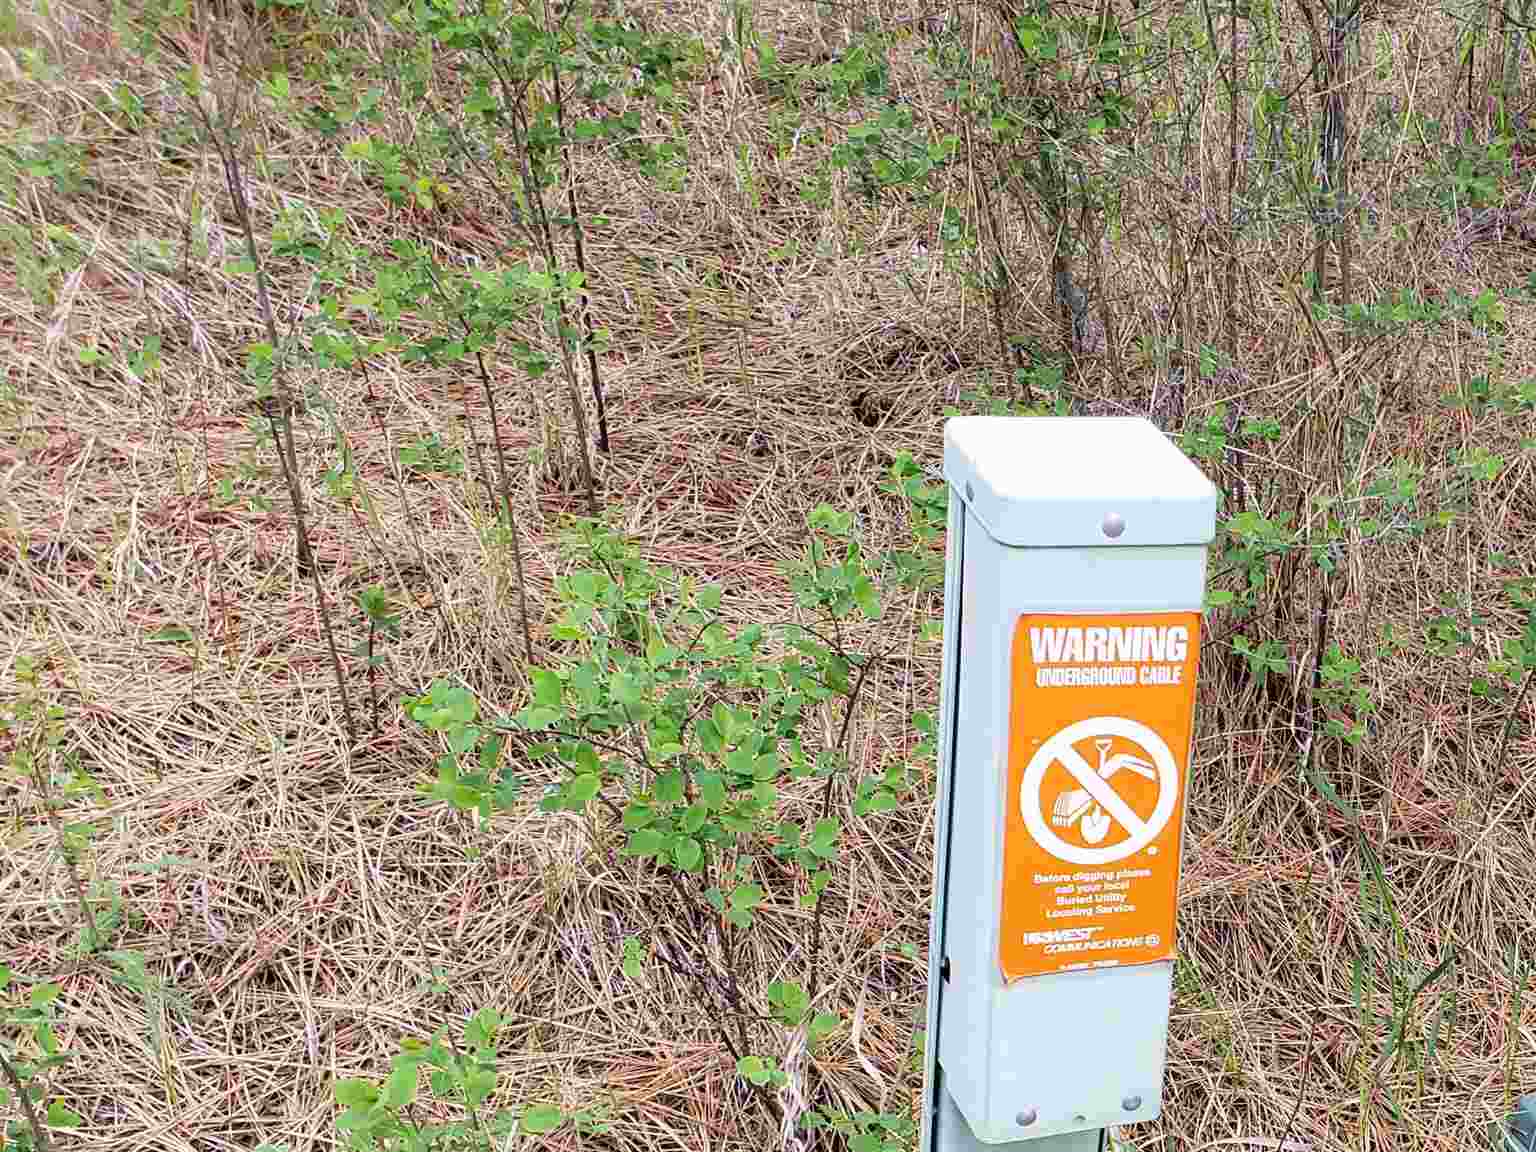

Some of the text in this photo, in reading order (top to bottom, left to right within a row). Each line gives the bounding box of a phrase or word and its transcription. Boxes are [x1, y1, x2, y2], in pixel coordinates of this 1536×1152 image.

[1029, 626, 1188, 663] WARNING
[1036, 665, 1183, 687] UNDERGROUND CABLE
